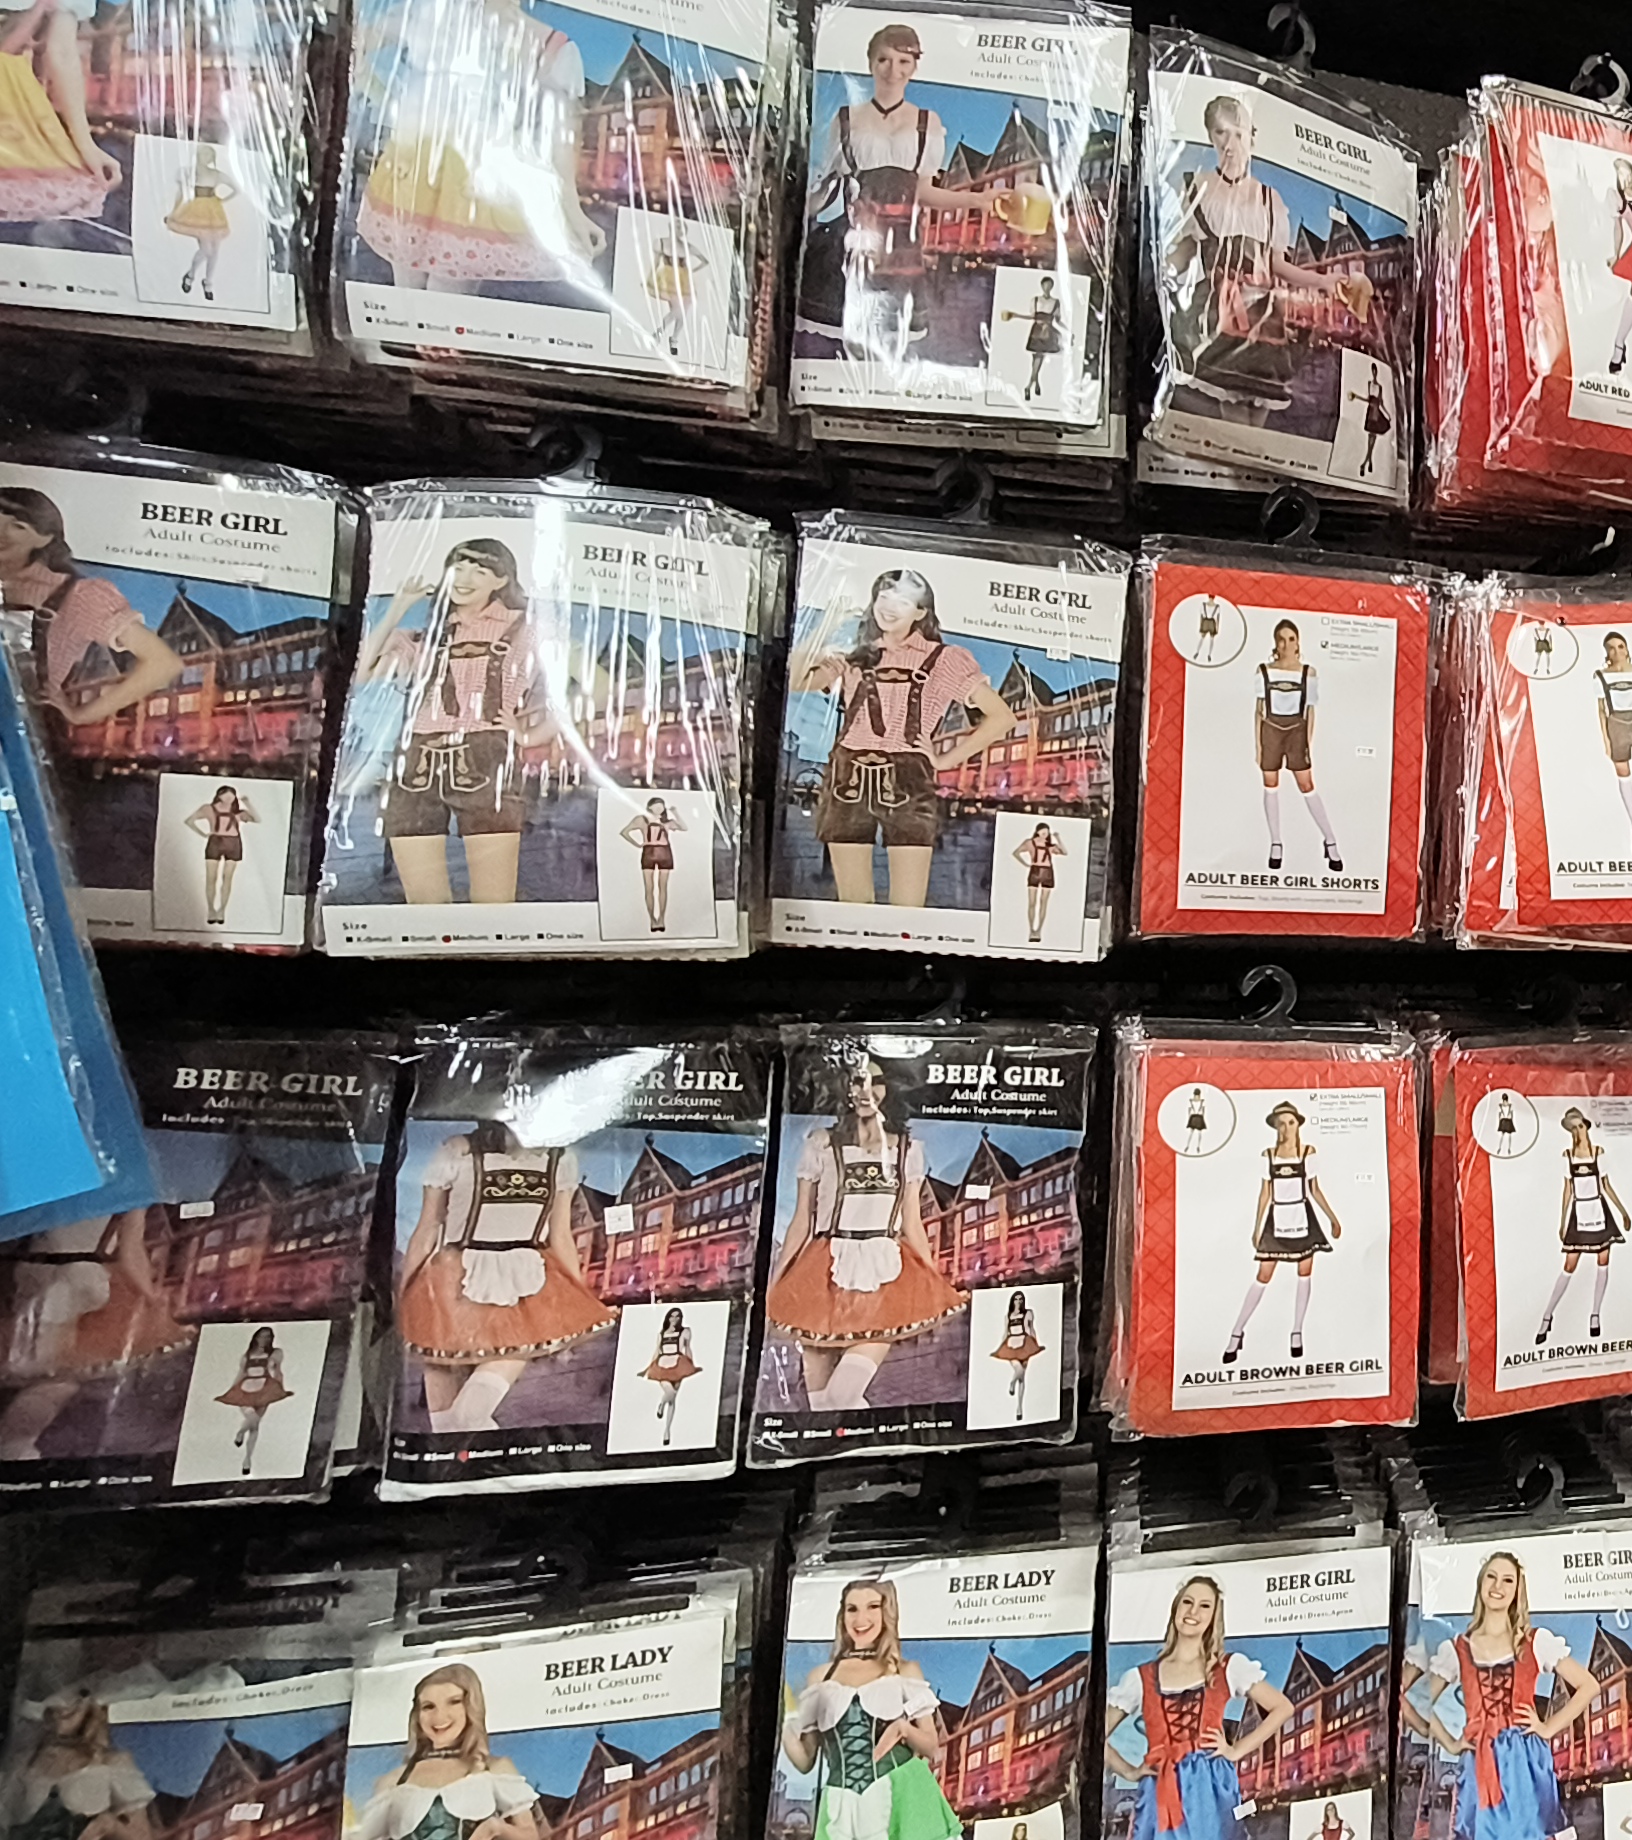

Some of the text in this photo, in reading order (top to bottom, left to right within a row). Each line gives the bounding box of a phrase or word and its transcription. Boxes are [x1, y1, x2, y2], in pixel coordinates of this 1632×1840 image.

[976, 34, 1028, 50] BEER
[977, 52, 1012, 64] Adult
[1294, 123, 1373, 164] BEER GIRL
[1299, 143, 1370, 175] Adult Costume
[1578, 381, 1609, 394] ADULT
[1611, 386, 1630, 399] RED
[141, 502, 288, 536] BEER GIRL
[143, 528, 281, 552] Adult Costume
[988, 581, 1041, 603] BEER
[991, 603, 1026, 616] Adult
[1557, 861, 1604, 873] ADULT
[1185, 873, 1380, 890] ADULT BEER GIRL SHORTS
[173, 1067, 363, 1096] BEER GIRL
[675, 1071, 744, 1091] GIRL
[926, 1064, 1065, 1087] BEER GIRL
[203, 1096, 254, 1109] Adult
[657, 1094, 722, 1108] Costume
[950, 1088, 1047, 1102] Adult Costume
[1503, 1350, 1545, 1367] ADULT
[1548, 1344, 1598, 1359] BROWN
[1601, 1340, 1632, 1353] BEER
[1182, 1358, 1383, 1385] ADULT BROWN BEER GIRL
[1563, 1552, 1604, 1570] BEER
[948, 1569, 1056, 1593] BEER LADY
[1265, 1569, 1356, 1593] BEER GIRL
[1564, 1572, 1593, 1585] Adult
[953, 1592, 1046, 1609] Adult Costume
[1265, 1590, 1349, 1609] Adult Costume
[544, 1645, 674, 1681] BEER LADY
[551, 1672, 663, 1697] Adult Costume
